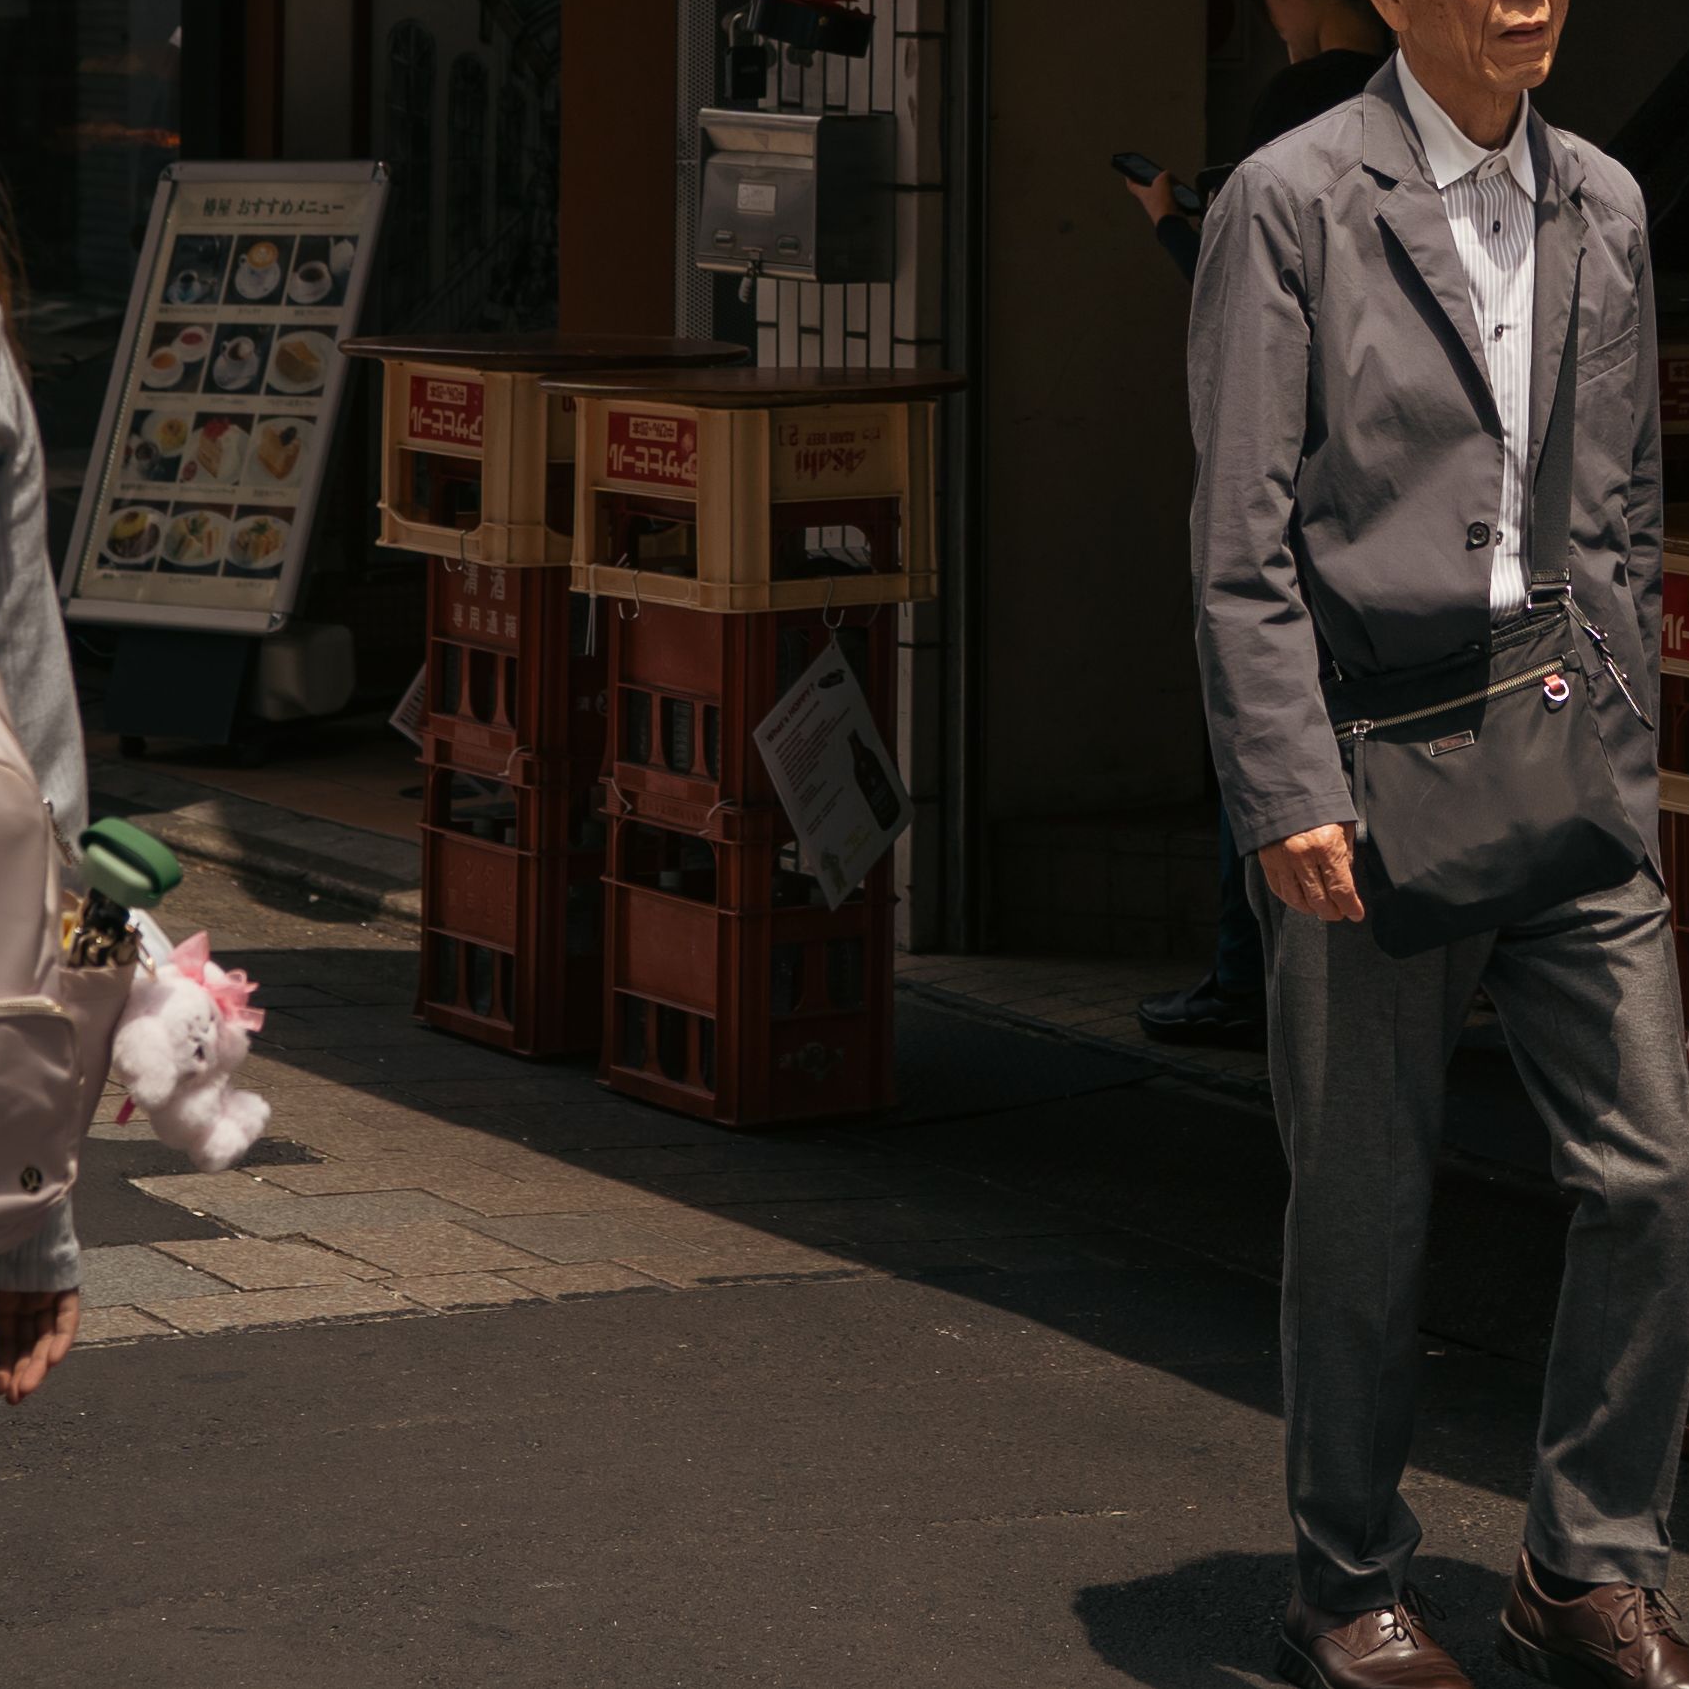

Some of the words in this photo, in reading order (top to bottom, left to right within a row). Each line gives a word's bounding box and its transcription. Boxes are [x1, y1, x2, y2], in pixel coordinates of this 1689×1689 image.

[236, 196, 346, 217] おすすめメニュー
[610, 443, 698, 487] アサヒビール
[794, 447, 866, 480] Asahi
